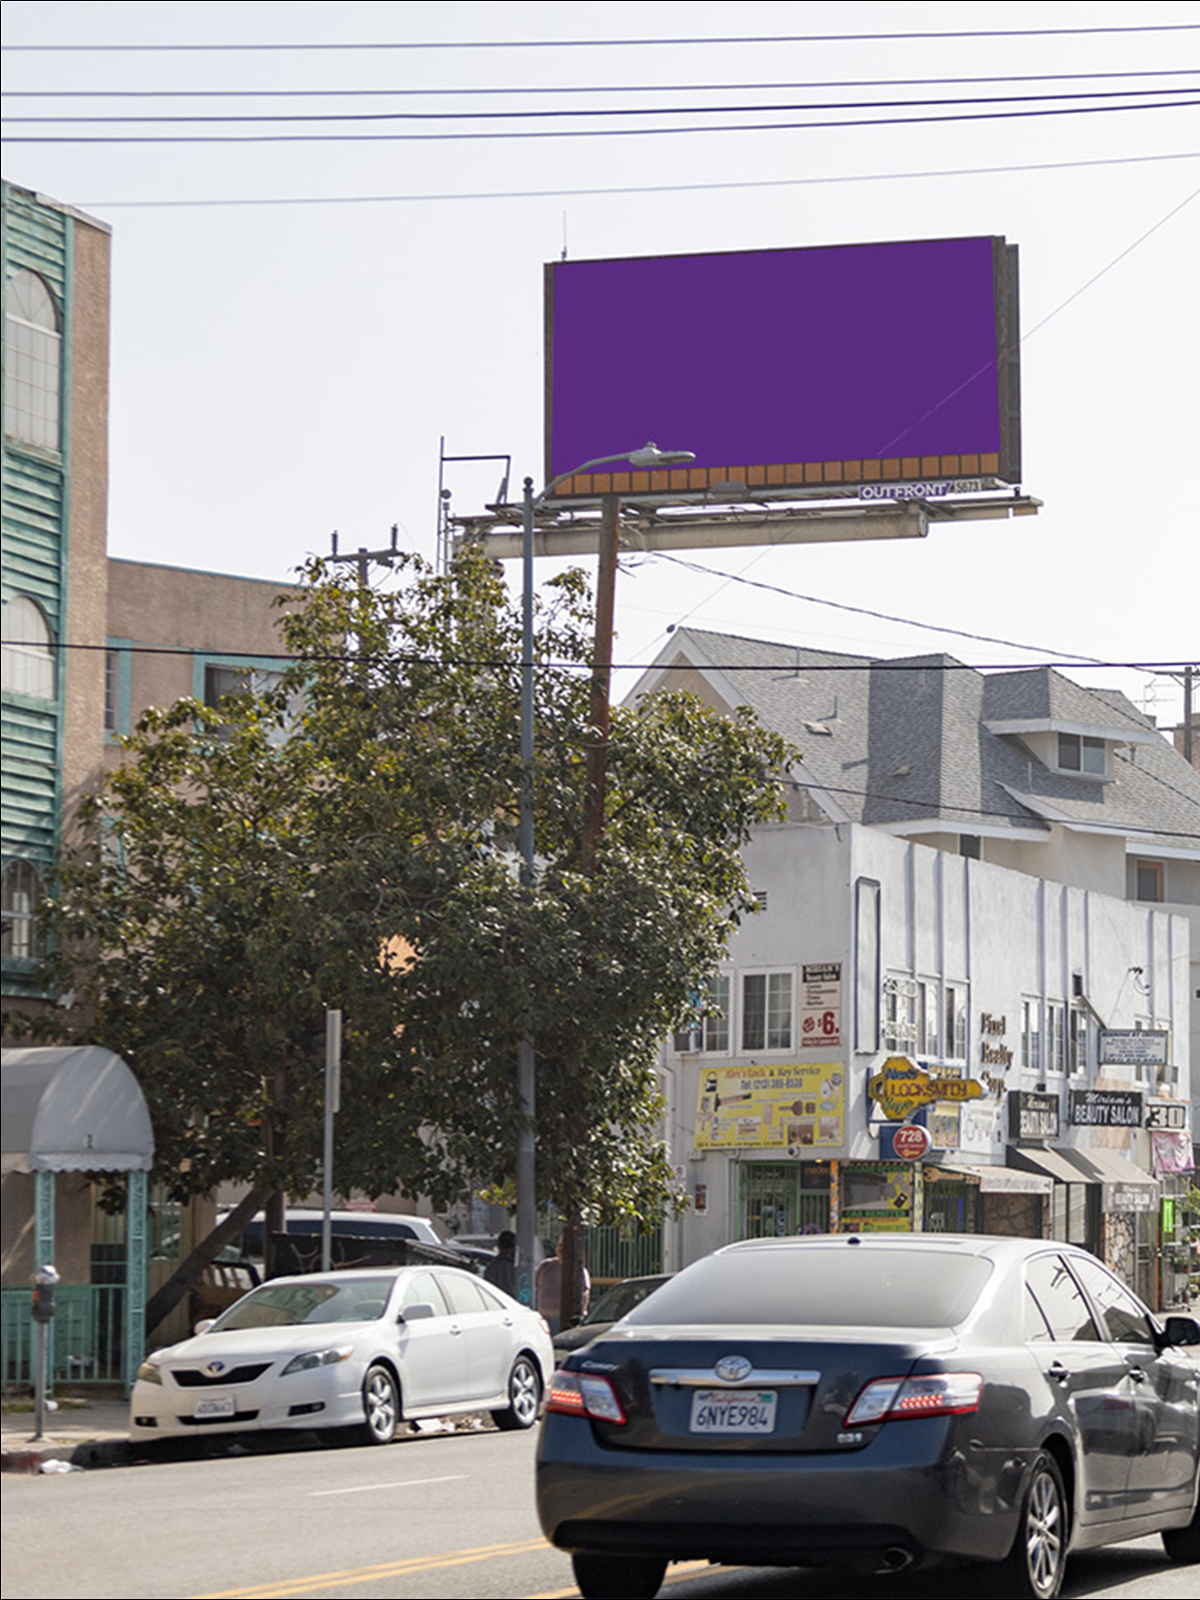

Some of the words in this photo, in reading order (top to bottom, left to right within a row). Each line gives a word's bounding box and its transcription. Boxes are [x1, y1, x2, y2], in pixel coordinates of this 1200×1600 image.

[748, 1067, 766, 1078] Lock
[793, 1066, 821, 1077] Service
[890, 1083, 967, 1098] LOCKSMITH
[1075, 1105, 1110, 1123] BEAUTY
[1110, 1105, 1140, 1124] SALON
[900, 1130, 922, 1142] 728
[696, 1405, 768, 1426] 6NYE984
